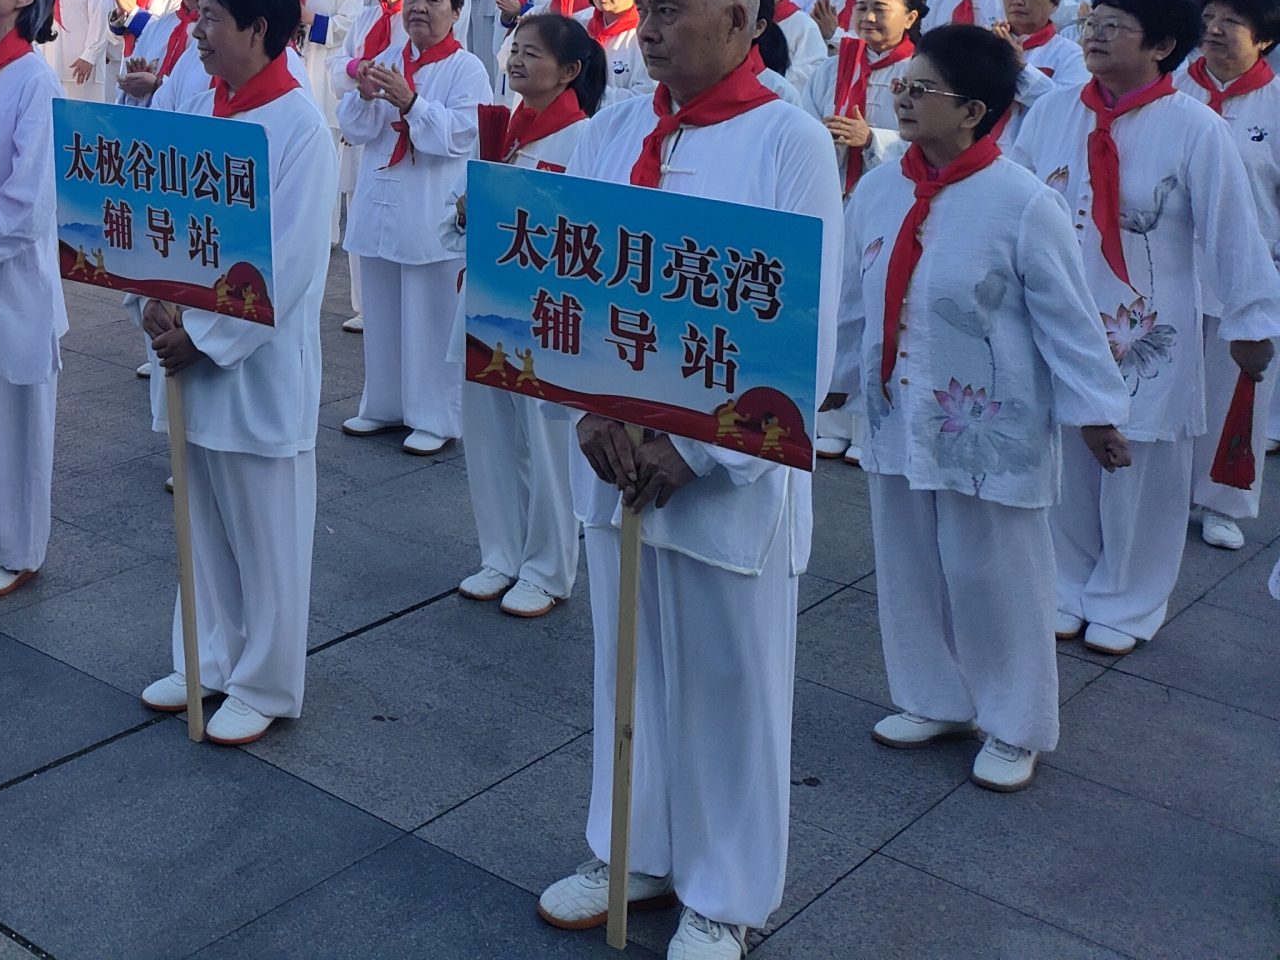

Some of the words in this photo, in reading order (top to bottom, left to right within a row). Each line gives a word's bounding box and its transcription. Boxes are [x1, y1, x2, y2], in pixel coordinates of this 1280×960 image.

[64, 132, 256, 209] 太极谷山公园
[103, 198, 220, 269] 辅导站
[497, 208, 786, 320] 太极月亮湾
[530, 288, 740, 394] 辅导站
